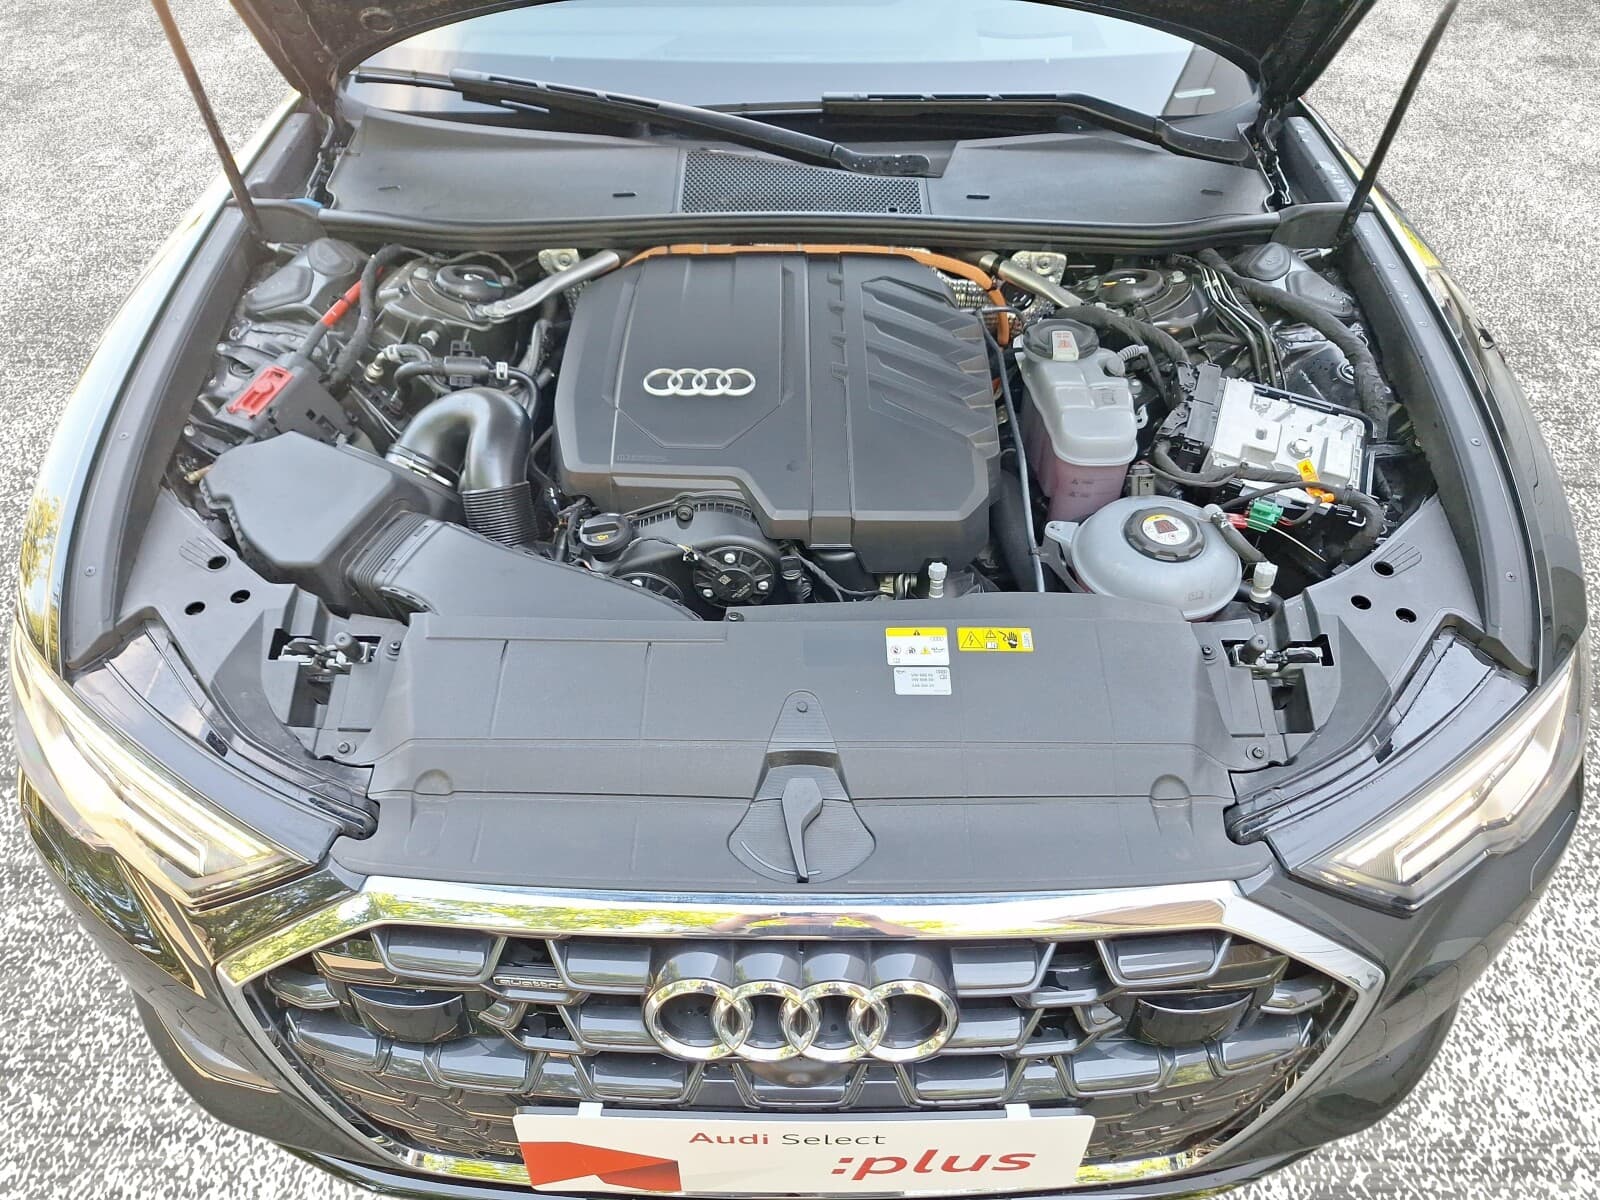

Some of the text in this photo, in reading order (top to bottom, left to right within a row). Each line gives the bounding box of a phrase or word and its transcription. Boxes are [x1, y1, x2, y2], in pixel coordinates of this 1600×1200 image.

[688, 1132, 887, 1145] Audi Select
[831, 1149, 1037, 1181] :plus
